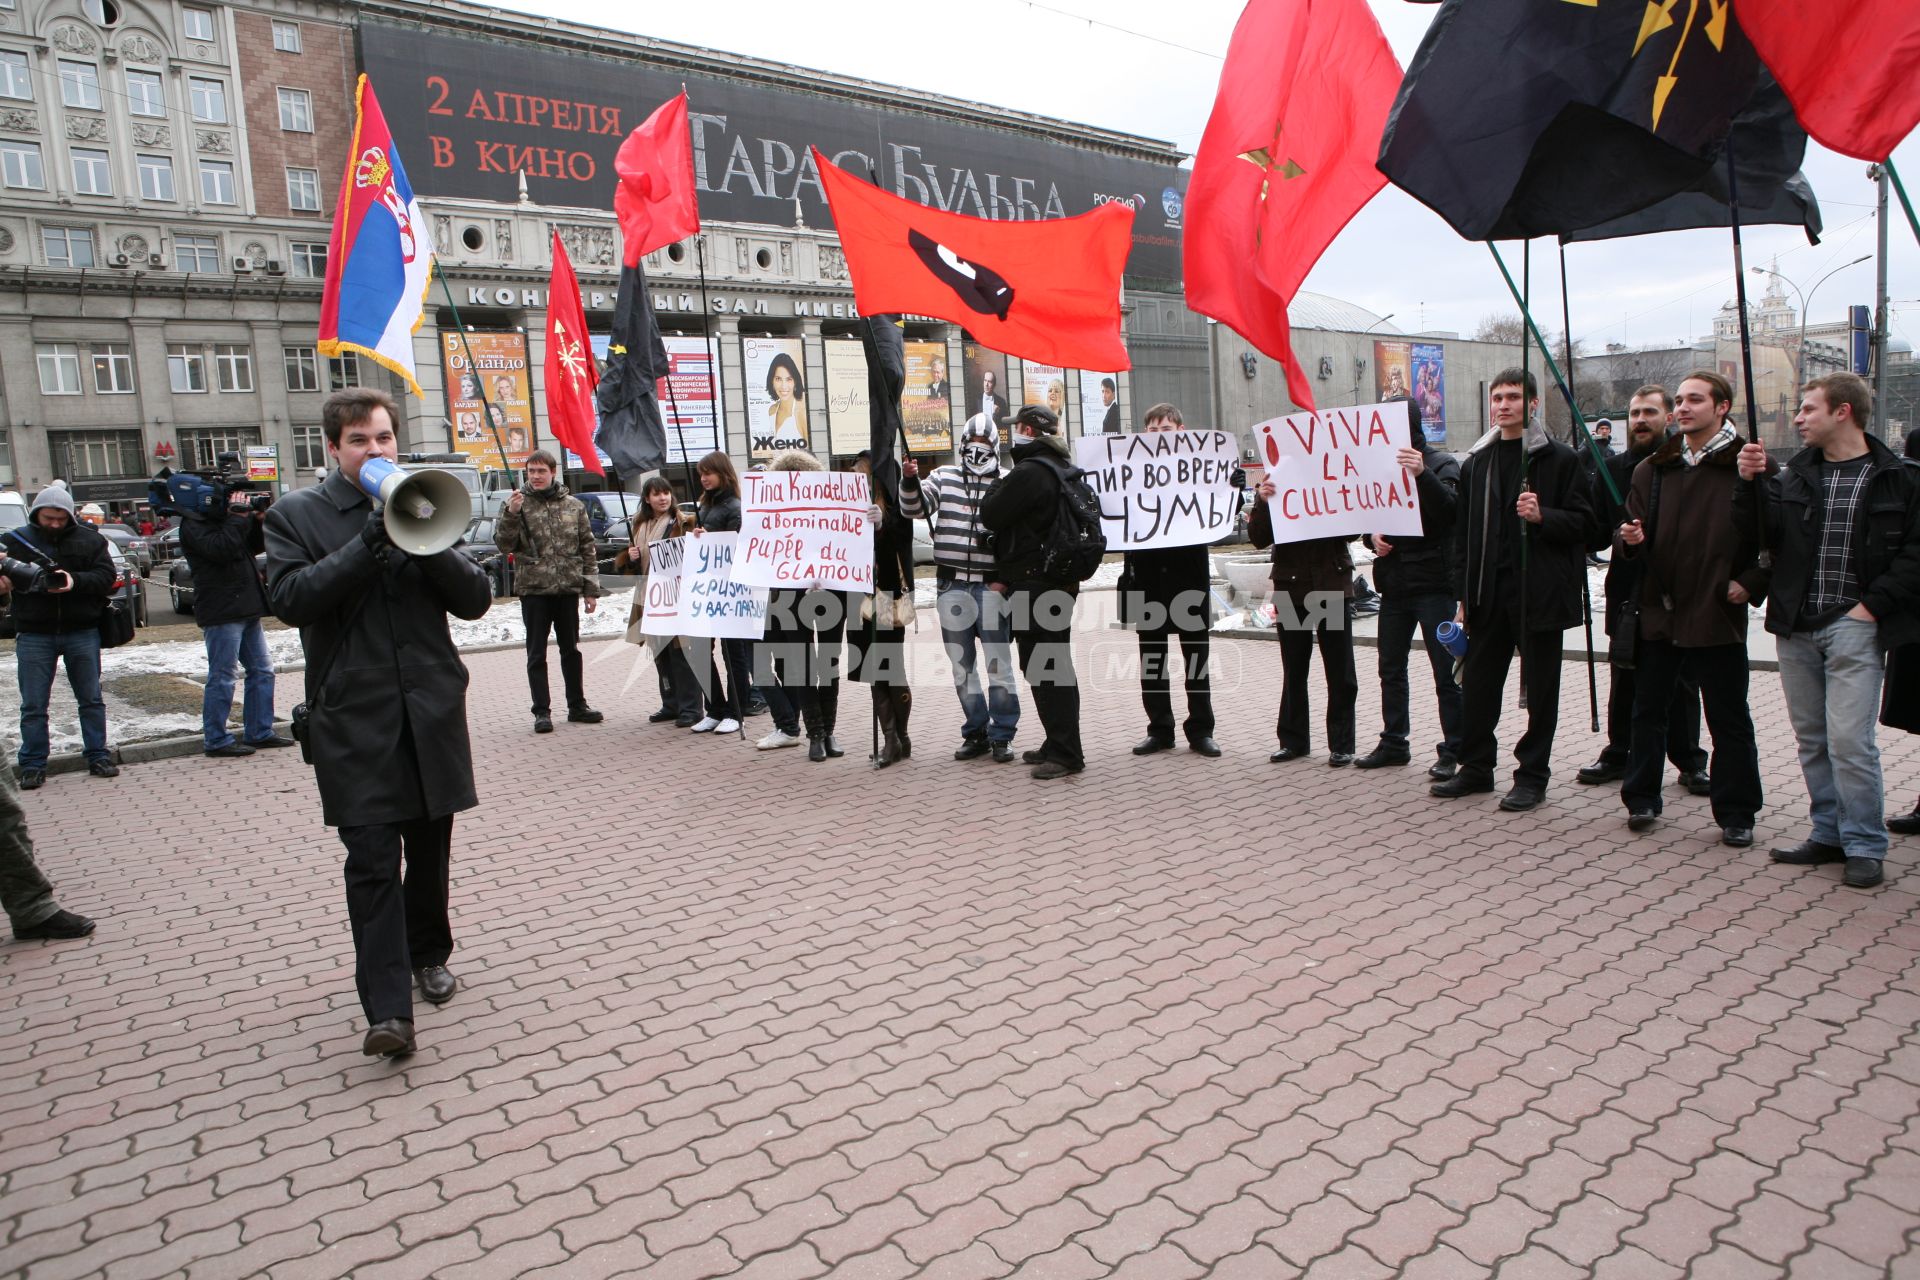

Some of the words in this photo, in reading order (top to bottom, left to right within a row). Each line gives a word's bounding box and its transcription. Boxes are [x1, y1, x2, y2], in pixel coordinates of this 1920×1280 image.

[426, 75, 454, 116] 2
[465, 88, 623, 137] АПРЕЛЯ
[429, 135, 456, 168] В
[475, 140, 597, 182] КИНО
[467, 286, 695, 312] КОНРЫЙ
[712, 296, 769, 314] ЗАЛ
[794, 301, 861, 318] ИМЕН
[447, 334, 459, 351] 5
[746, 340, 759, 359] 8
[696, 416, 718, 424] РЕПИ
[753, 436, 808, 451] Жено
[1106, 432, 1227, 464] ГЛАМУР
[1082, 464, 1133, 493] ПИР
[1144, 463, 1172, 489] ВО
[1323, 452, 1359, 480] LA
[744, 475, 784, 504] Tina
[1100, 491, 1236, 543] ЧУМЫ
[714, 544, 737, 569] НА
[820, 541, 848, 561] du
